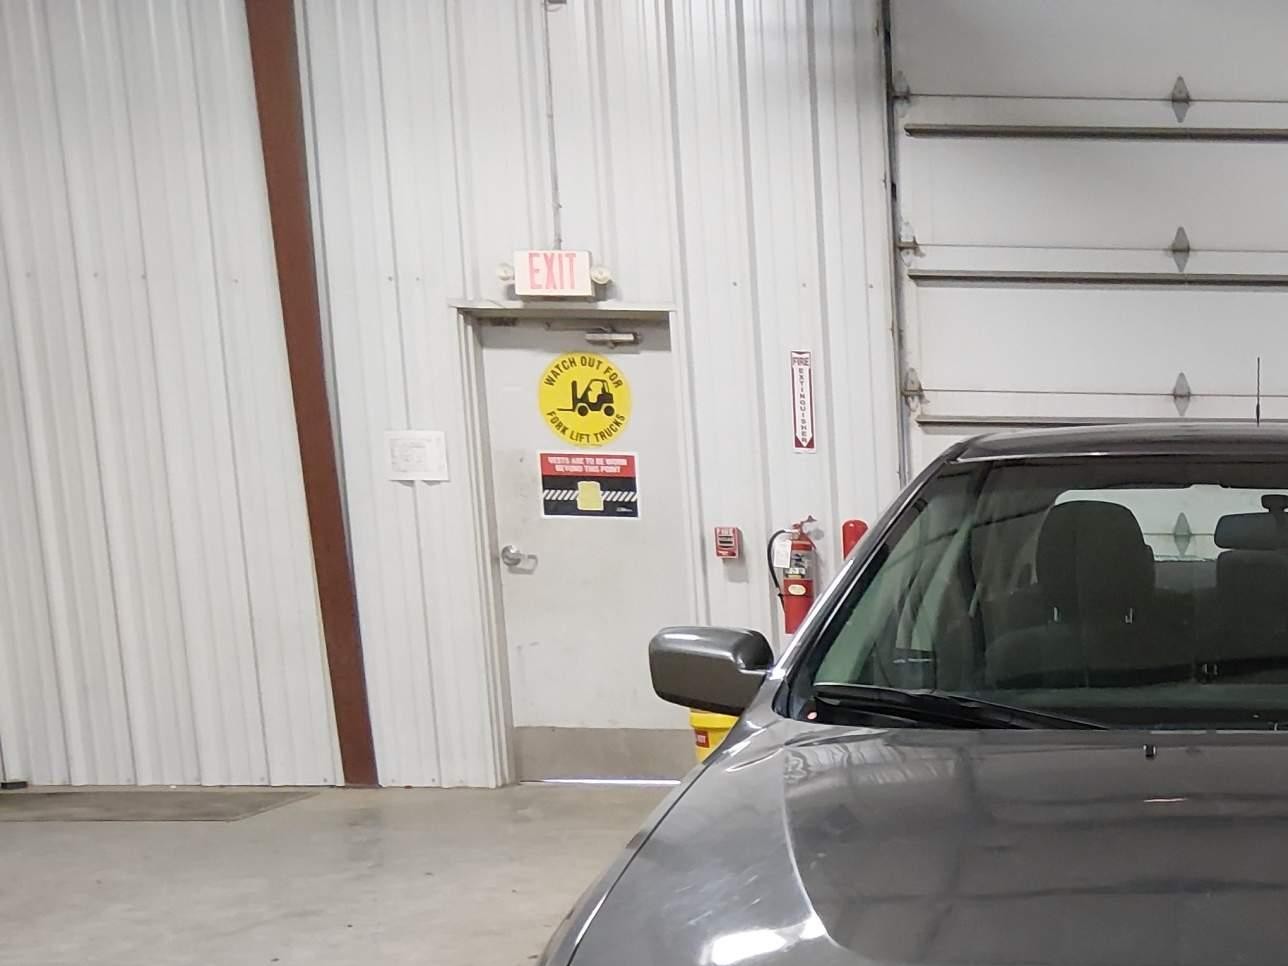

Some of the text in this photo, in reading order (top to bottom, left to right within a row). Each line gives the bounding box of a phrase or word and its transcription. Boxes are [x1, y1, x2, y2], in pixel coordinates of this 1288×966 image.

[527, 252, 576, 289] EXIT
[544, 356, 624, 388] WATCH OUT FOR
[799, 367, 807, 443] EXTINGUISHER
[546, 411, 625, 443] FORK LIFT TRUCKS
